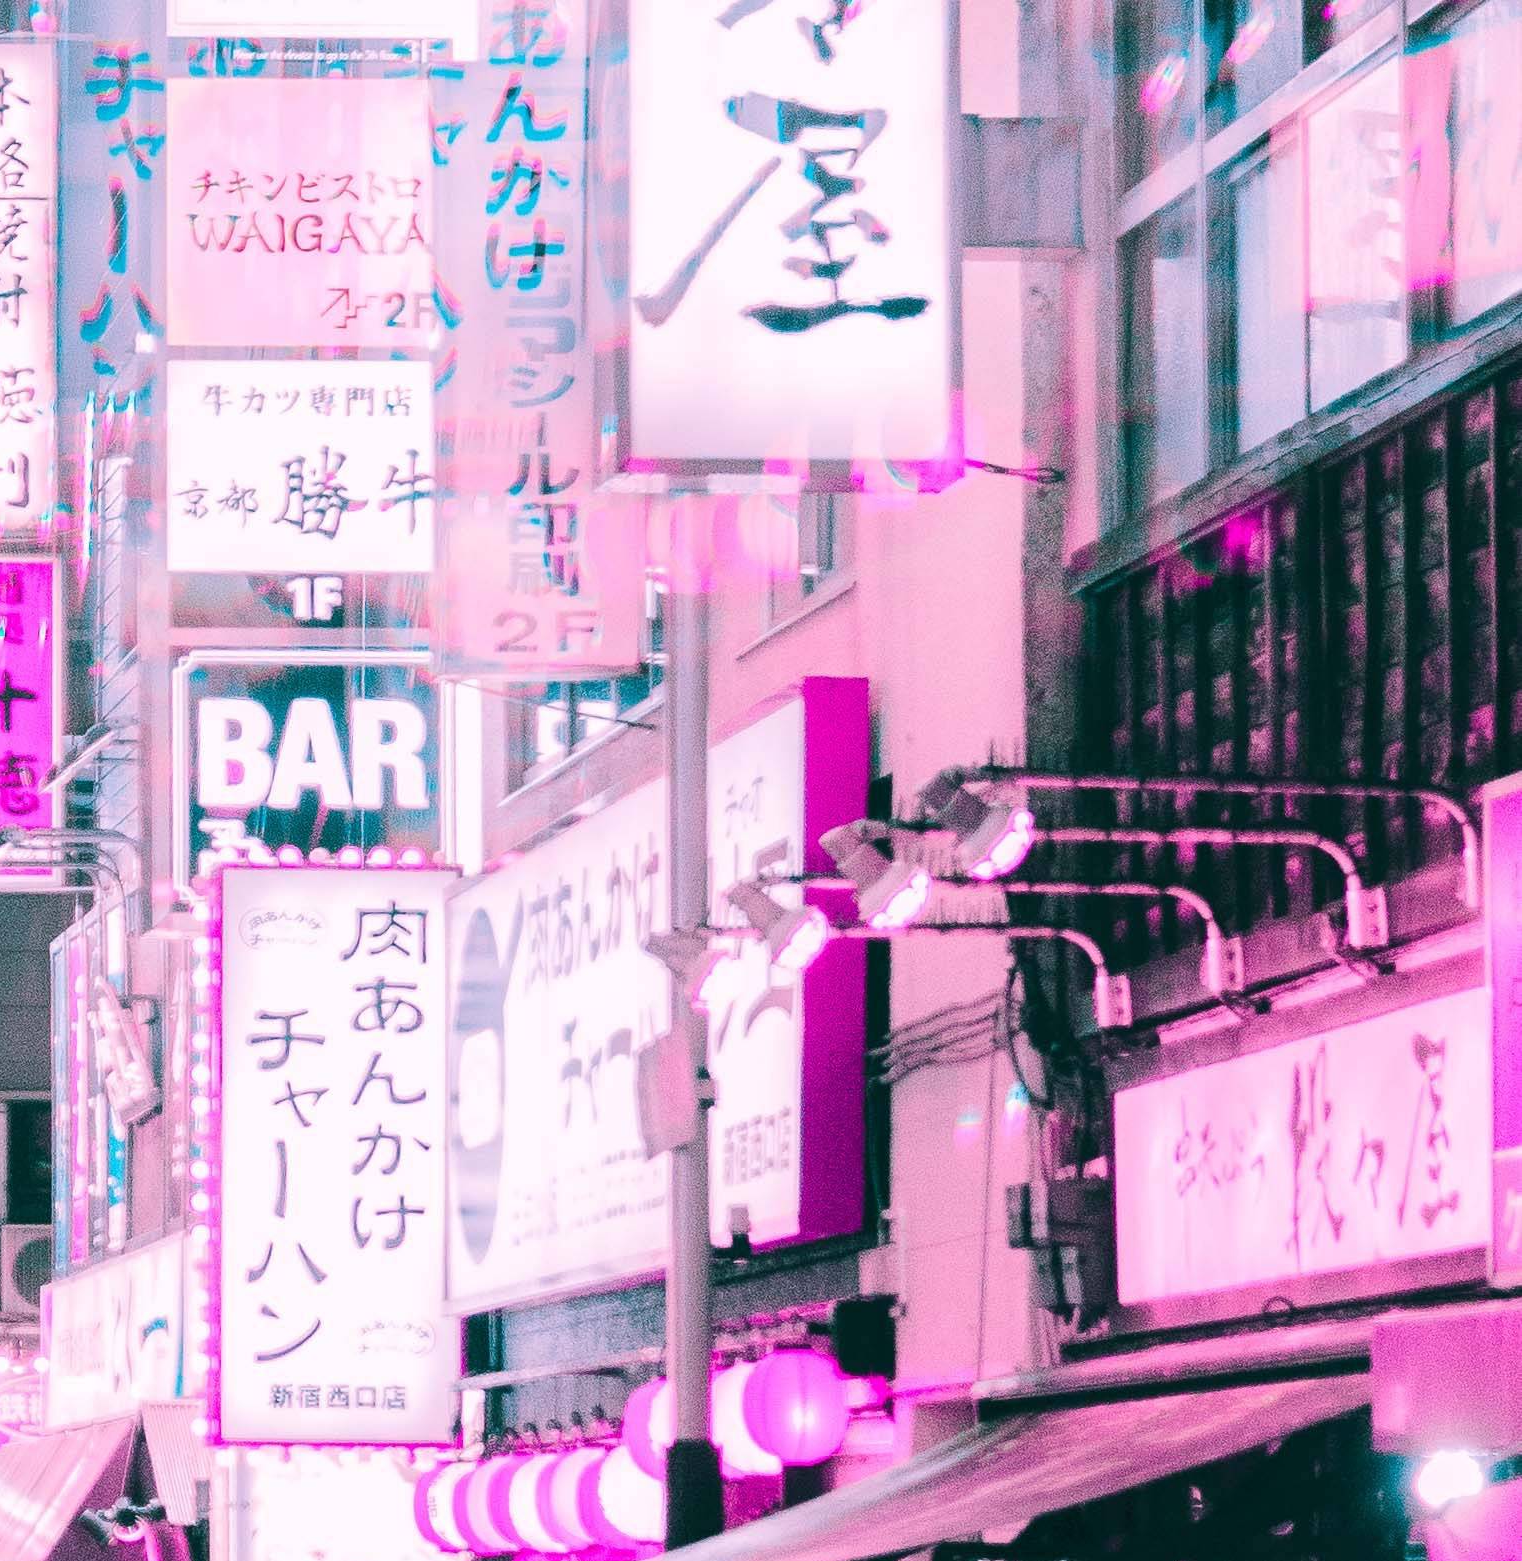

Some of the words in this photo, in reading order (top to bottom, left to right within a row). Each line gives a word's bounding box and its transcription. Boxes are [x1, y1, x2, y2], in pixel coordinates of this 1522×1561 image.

[190, 169, 423, 204] チキンビストロ
[190, 213, 426, 254] WAIGAYA
[203, 384, 413, 417] 牛カツ専門店
[175, 480, 259, 527] 京都
[287, 577, 344, 622] 1F
[197, 697, 431, 811] BAR
[340, 901, 432, 1250] 肉あんかけ
[246, 1008, 329, 1363] チャーハン
[269, 1384, 407, 1412] 新宿西口店
